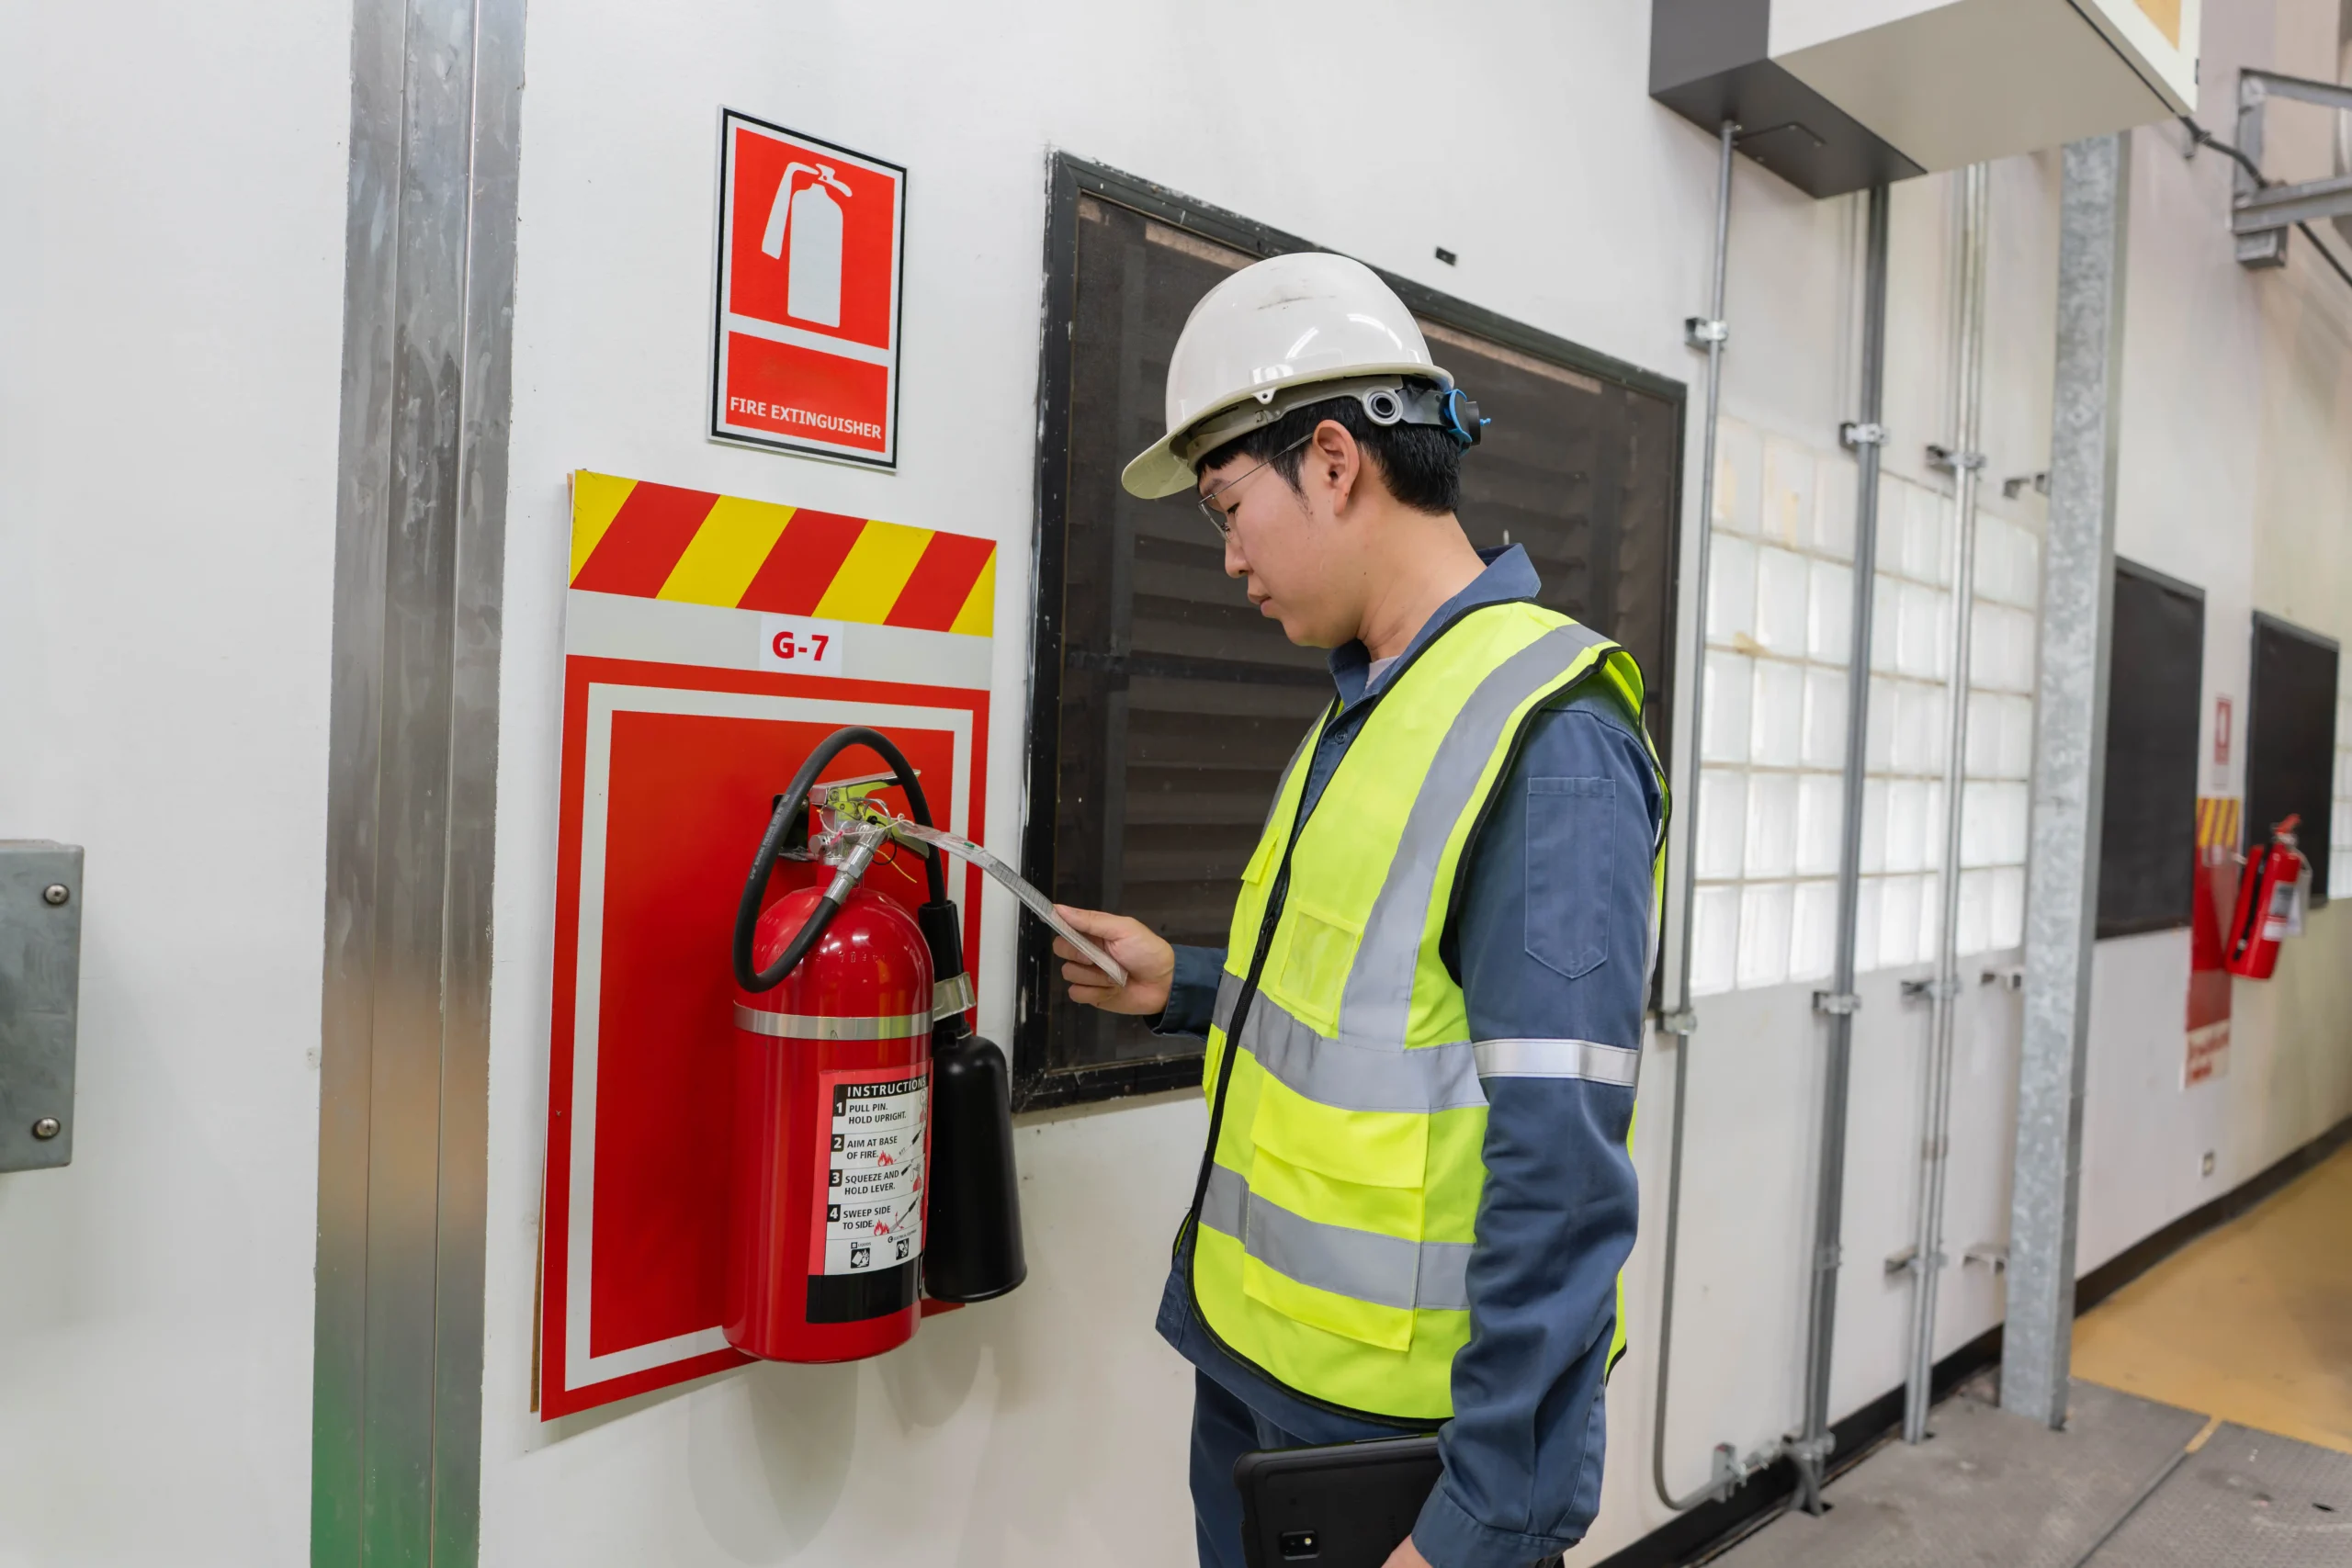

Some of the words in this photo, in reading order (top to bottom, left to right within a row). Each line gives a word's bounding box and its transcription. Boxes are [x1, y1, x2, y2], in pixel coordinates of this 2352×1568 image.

[729, 396, 766, 417] FIRE
[771, 404, 882, 440] EXTINGUISHER
[771, 630, 831, 662] G-7
[847, 1077, 926, 1097] INSTRUCTIONS
[836, 1102, 842, 1113] 1
[849, 1104, 870, 1113] PULL
[872, 1102, 888, 1111] PIN.
[848, 1115, 873, 1125] HOLD
[875, 1111, 907, 1123] UPRIGHT.
[833, 1137, 842, 1148] 2
[847, 1139, 865, 1148] AIM
[866, 1138, 877, 1147] AT
[878, 1135, 898, 1146] BASE
[846, 1151, 858, 1160] OF
[860, 1149, 879, 1159] FIRE.
[831, 1172, 840, 1184] 3
[845, 1173, 882, 1184] SQUEEZE
[883, 1169, 899, 1180] AND
[844, 1186, 868, 1195] HOLD
[870, 1182, 896, 1193] LEVER.
[830, 1207, 838, 1219] 4
[843, 1209, 872, 1219] SWEEP
[874, 1205, 891, 1216] SIDE
[842, 1222, 854, 1230] TO
[855, 1219, 875, 1230] SIDE.
